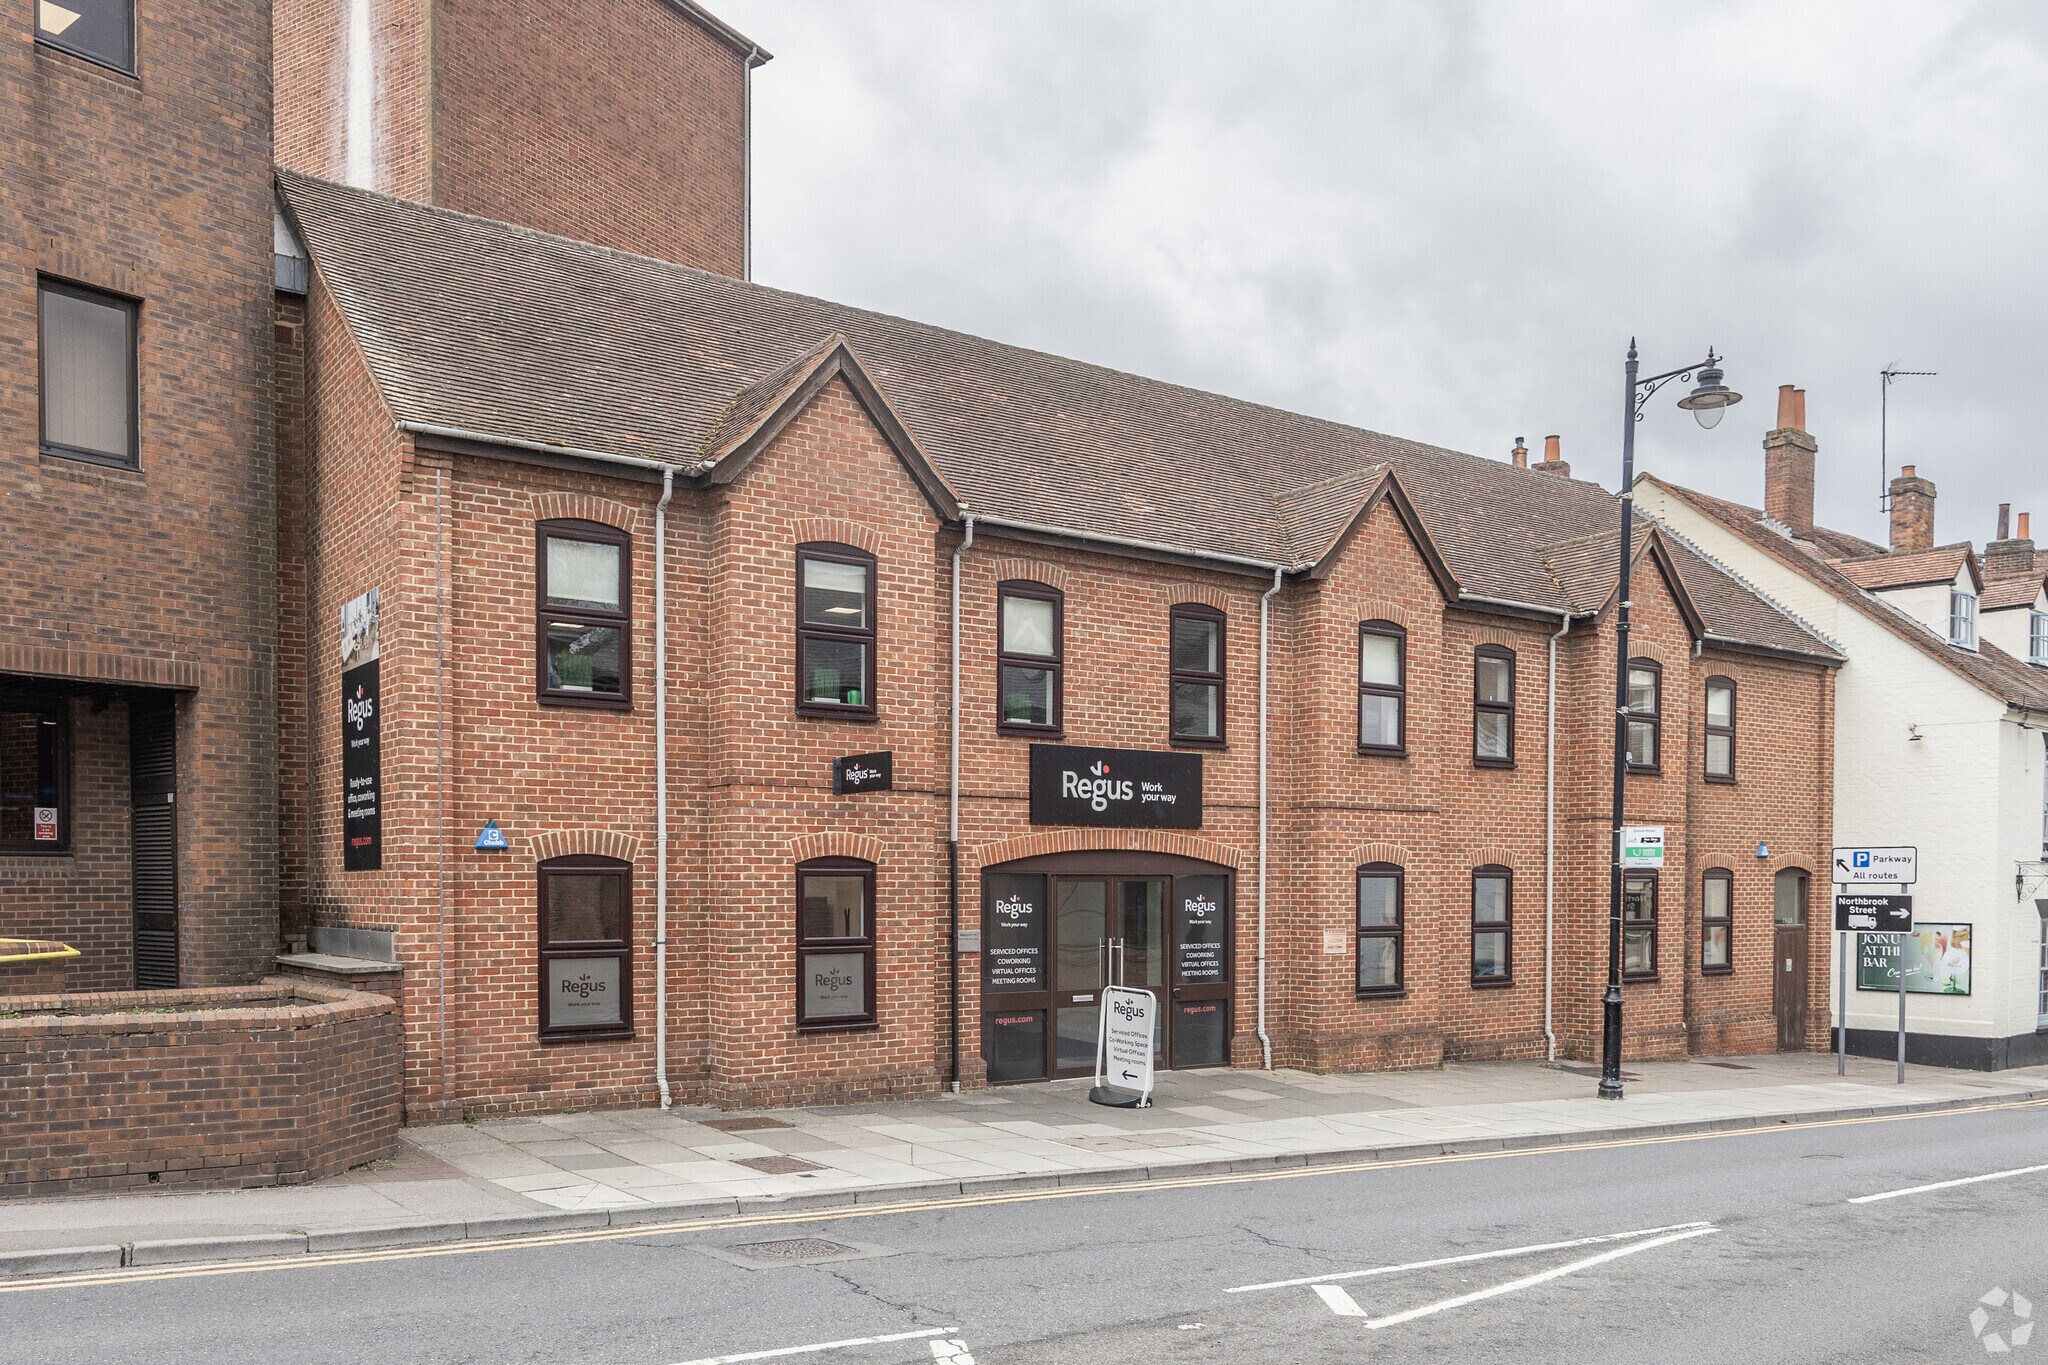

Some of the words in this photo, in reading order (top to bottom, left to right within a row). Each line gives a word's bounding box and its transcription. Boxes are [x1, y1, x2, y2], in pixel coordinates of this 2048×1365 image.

[347, 698, 373, 731] Regus
[350, 776, 373, 789] Ready-to-use
[846, 769, 868, 785] Regus
[1062, 770, 1134, 812] Regus
[1141, 781, 1163, 792] Work
[358, 790, 376, 802] coworking
[1141, 794, 1159, 803] your
[1160, 794, 1177, 804] way
[351, 807, 365, 819] meeting
[365, 807, 376, 816] rooms
[351, 836, 373, 848] regus.com
[1855, 852, 1868, 867] P
[1873, 855, 1912, 864] Parkway
[1838, 897, 1889, 905] Northbrook
[996, 900, 1033, 919] Regus
[1185, 899, 1216, 917] Regus
[1849, 906, 1877, 914] Street
[1861, 933, 1889, 945] JOIN
[1890, 934, 1901, 944] U
[1186, 951, 1215, 959] COWORKING
[1862, 945, 1879, 956] AT
[997, 957, 1031, 965] COWORKING
[1863, 957, 1888, 968] BAR
[991, 967, 1014, 975] VIRTUAL
[815, 973, 853, 991] Regus
[991, 977, 1016, 985] MEETING
[562, 979, 606, 998] Regus
[1114, 1001, 1145, 1021] Regus
[1184, 1005, 1216, 1015] regus.com
[995, 1015, 1033, 1026] regus.com
[1111, 1028, 1130, 1037] Serviced
[1130, 1031, 1148, 1039] Offices
[1108, 1036, 1134, 1047] Co-Working
[1113, 1046, 1128, 1054] Virtual
[1128, 1048, 1146, 1057] Offices
[1113, 1055, 1131, 1065] Meeting
